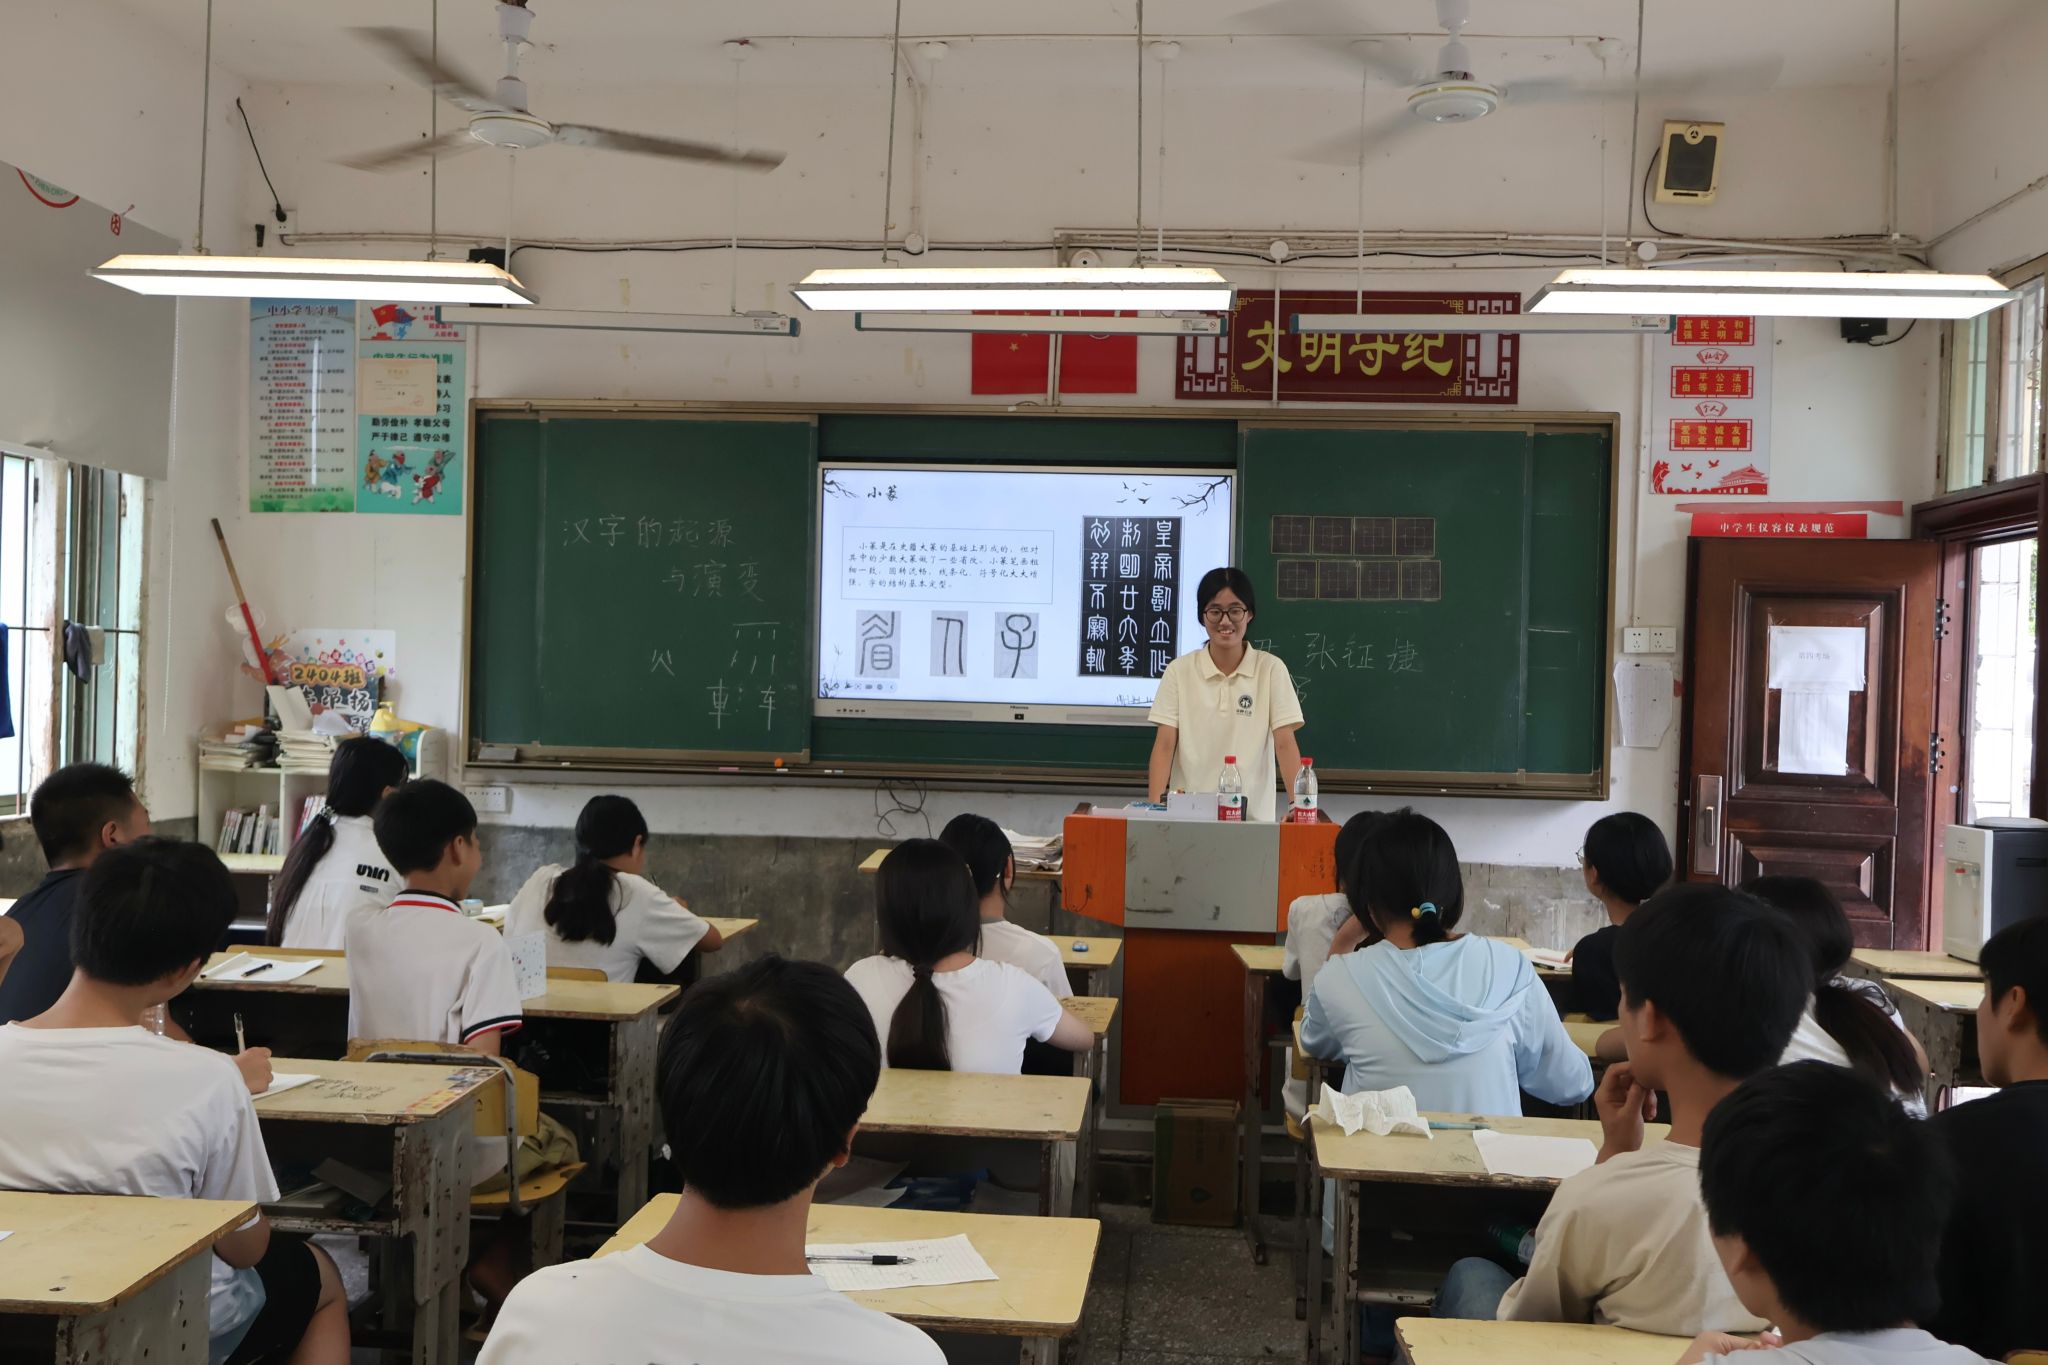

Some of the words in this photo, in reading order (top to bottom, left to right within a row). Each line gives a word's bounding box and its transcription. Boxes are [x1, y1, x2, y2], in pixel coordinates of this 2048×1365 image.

[268, 304, 338, 316] 中小学生守则
[1717, 319, 1727, 340] 文明
[1241, 320, 1454, 377] 文明守纪
[1682, 373, 1691, 392] 自由
[1699, 373, 1708, 393] 平等
[1715, 373, 1725, 393] 公正
[1732, 373, 1742, 393] 法治
[1703, 403, 1719, 413] 个人
[1681, 425, 1690, 445] 爱国
[1715, 425, 1724, 446] 诚信
[867, 484, 899, 502] 小篆
[563, 514, 736, 549] 汉字的起源
[1720, 521, 1836, 534] 中学生仪容仪表规范
[662, 559, 766, 602] 与演变
[294, 666, 362, 686] 2404班
